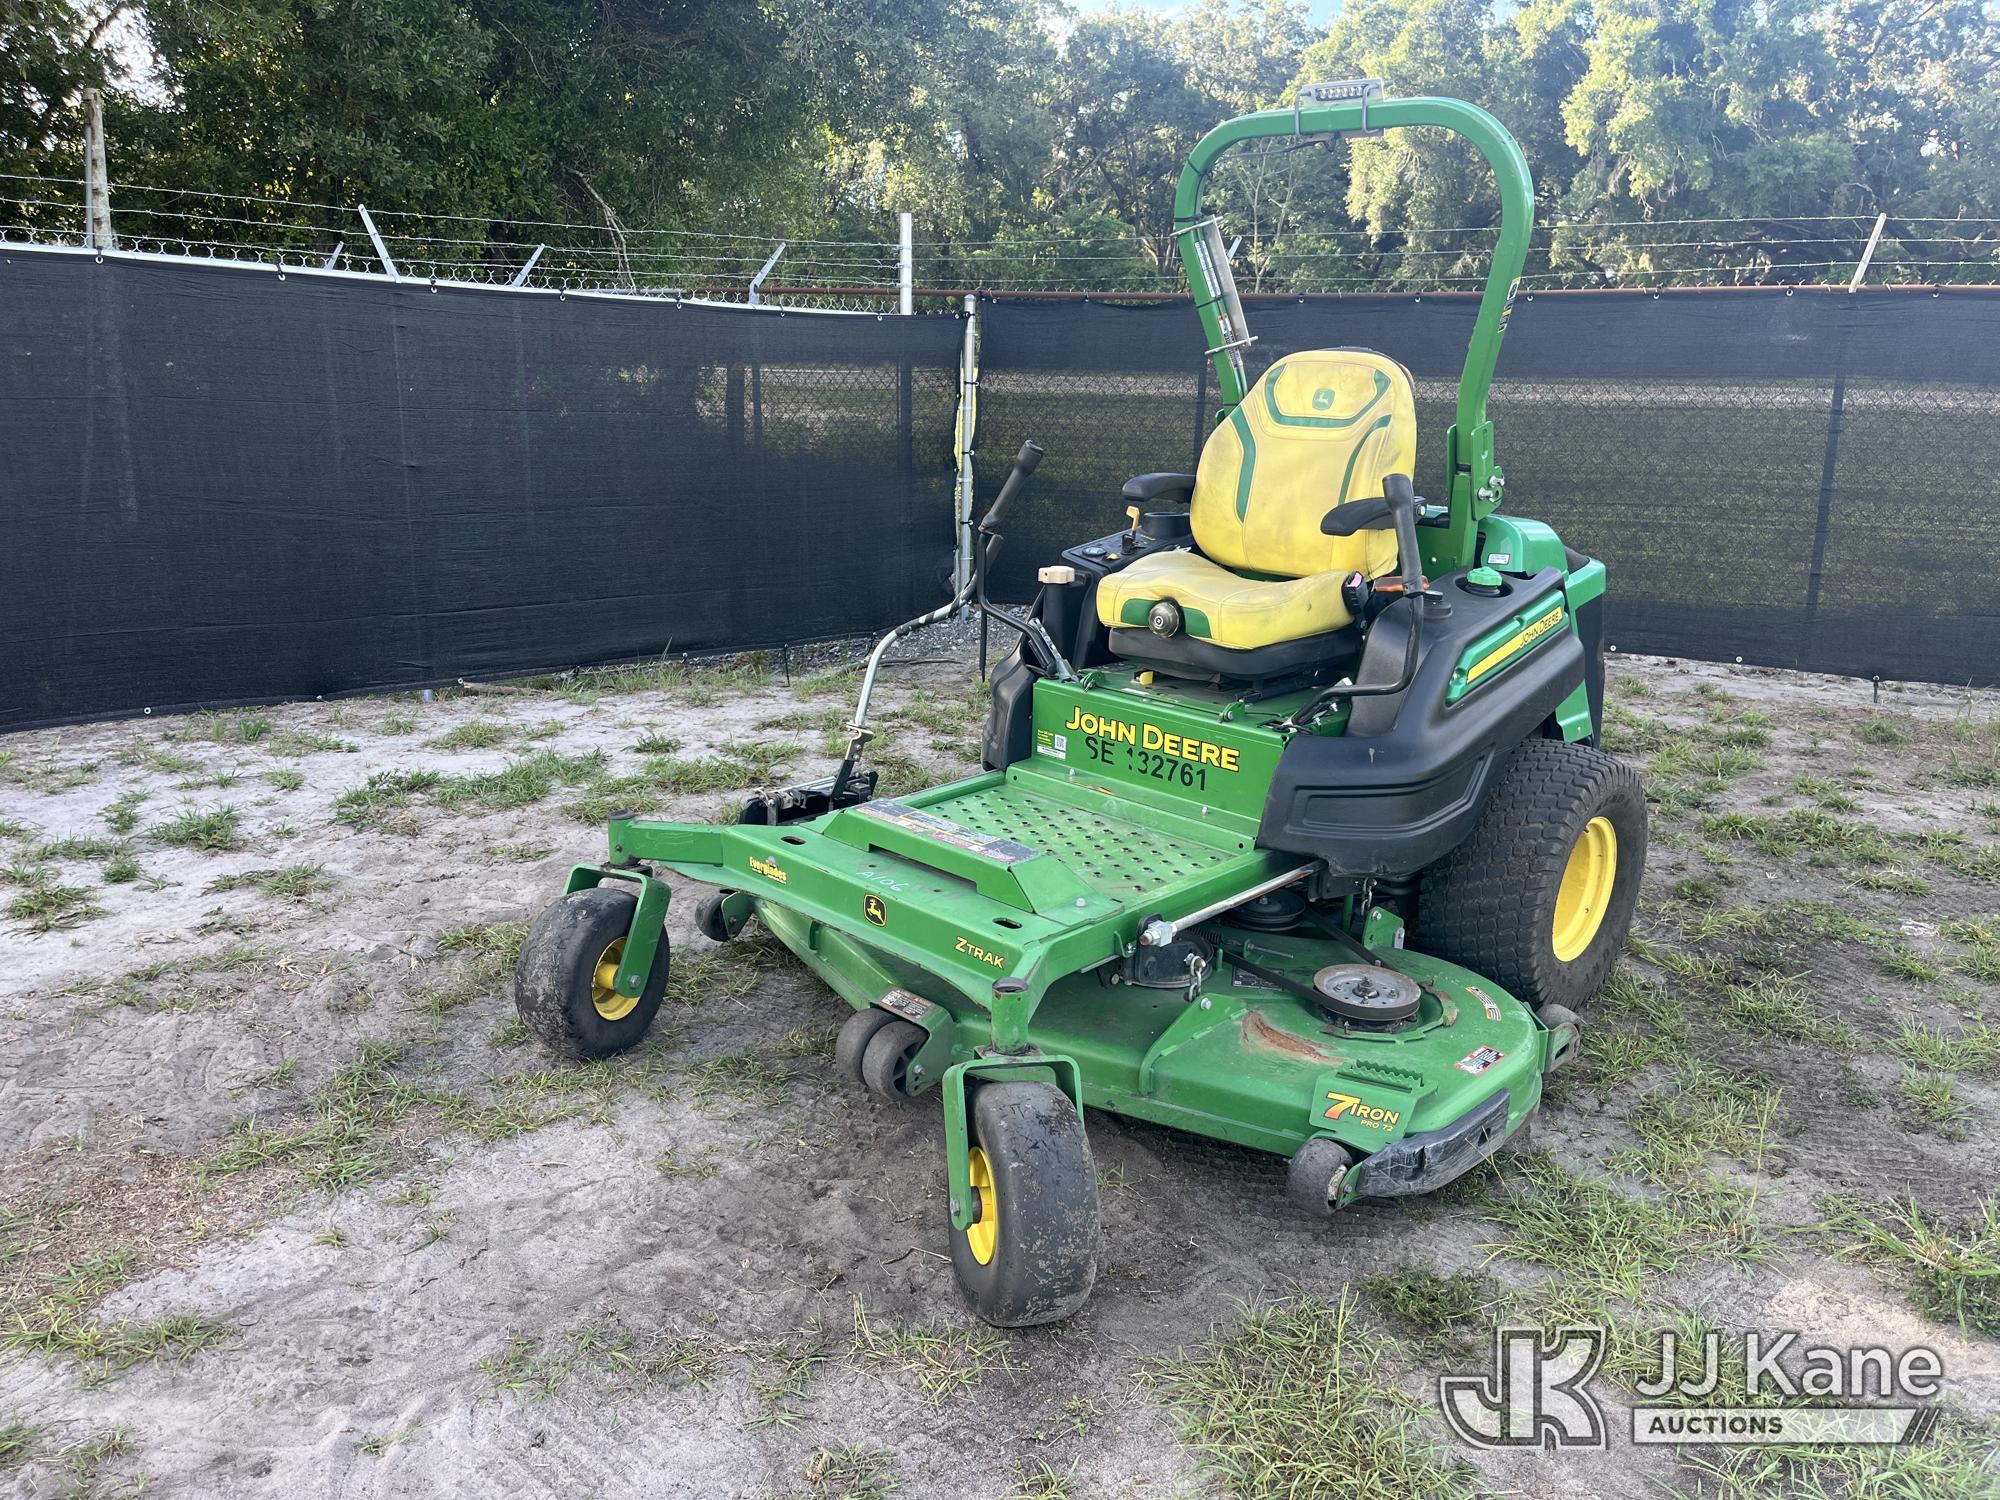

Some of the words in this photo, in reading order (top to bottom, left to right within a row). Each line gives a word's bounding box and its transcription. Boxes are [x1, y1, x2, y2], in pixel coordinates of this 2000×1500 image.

[1520, 628, 1540, 648] JOHN
[1540, 611, 1560, 634] DEERE
[1066, 706, 1136, 746] JOHN
[1142, 723, 1240, 772] DEERE
[1085, 736, 1115, 765] SE
[1126, 747, 1206, 791] 132761
[749, 856, 787, 881] Everglades
[955, 936, 1004, 969] ZTRAK
[1360, 1119, 1380, 1129] PRO
[1382, 1124, 1394, 1132] 72
